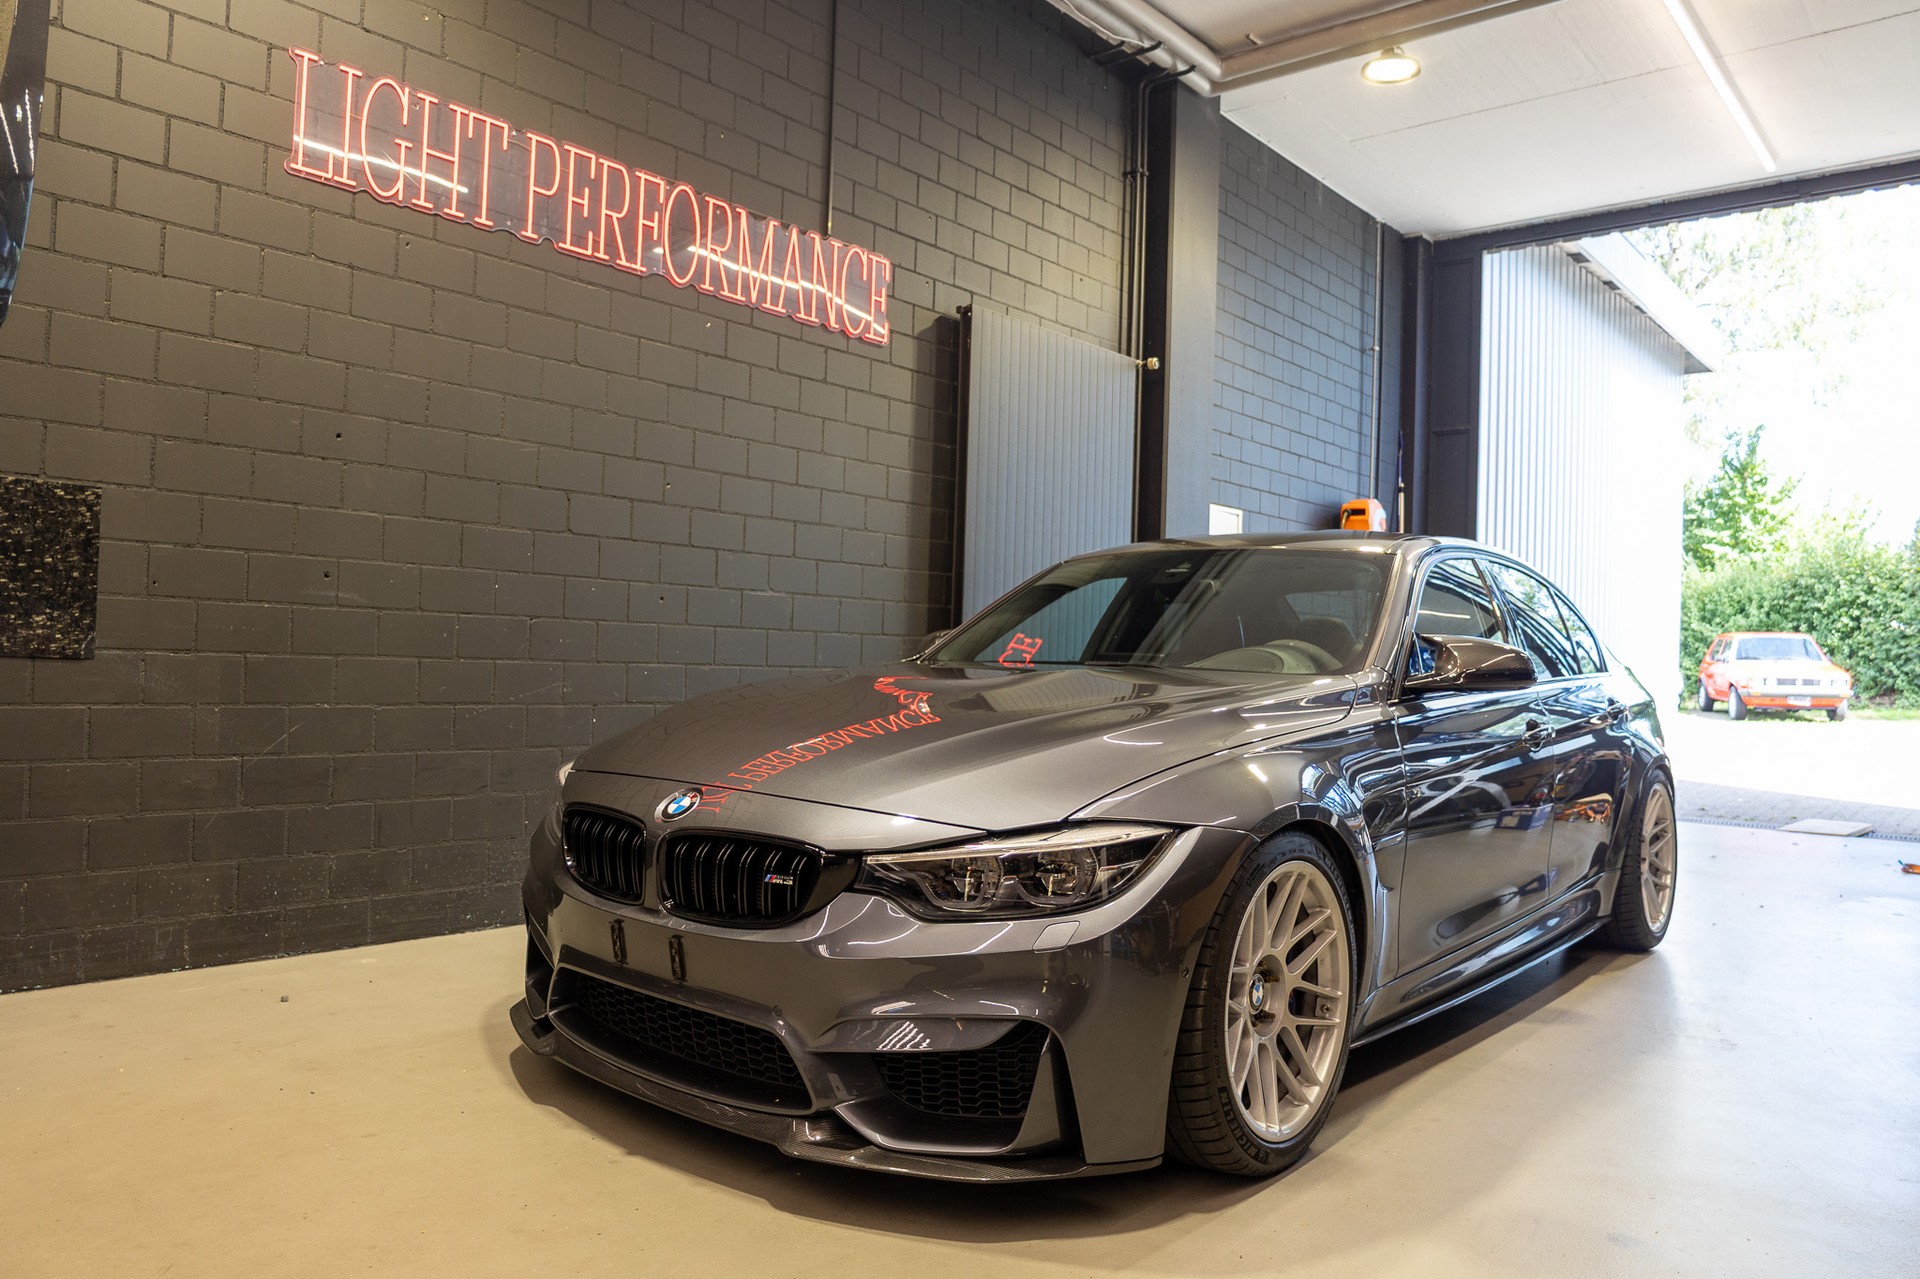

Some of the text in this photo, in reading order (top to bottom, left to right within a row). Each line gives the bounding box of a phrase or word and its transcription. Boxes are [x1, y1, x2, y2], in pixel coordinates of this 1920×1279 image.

[291, 48, 889, 343] LIGHT PERFORMANCE
[1220, 1091, 1259, 1157] MICHELIN
